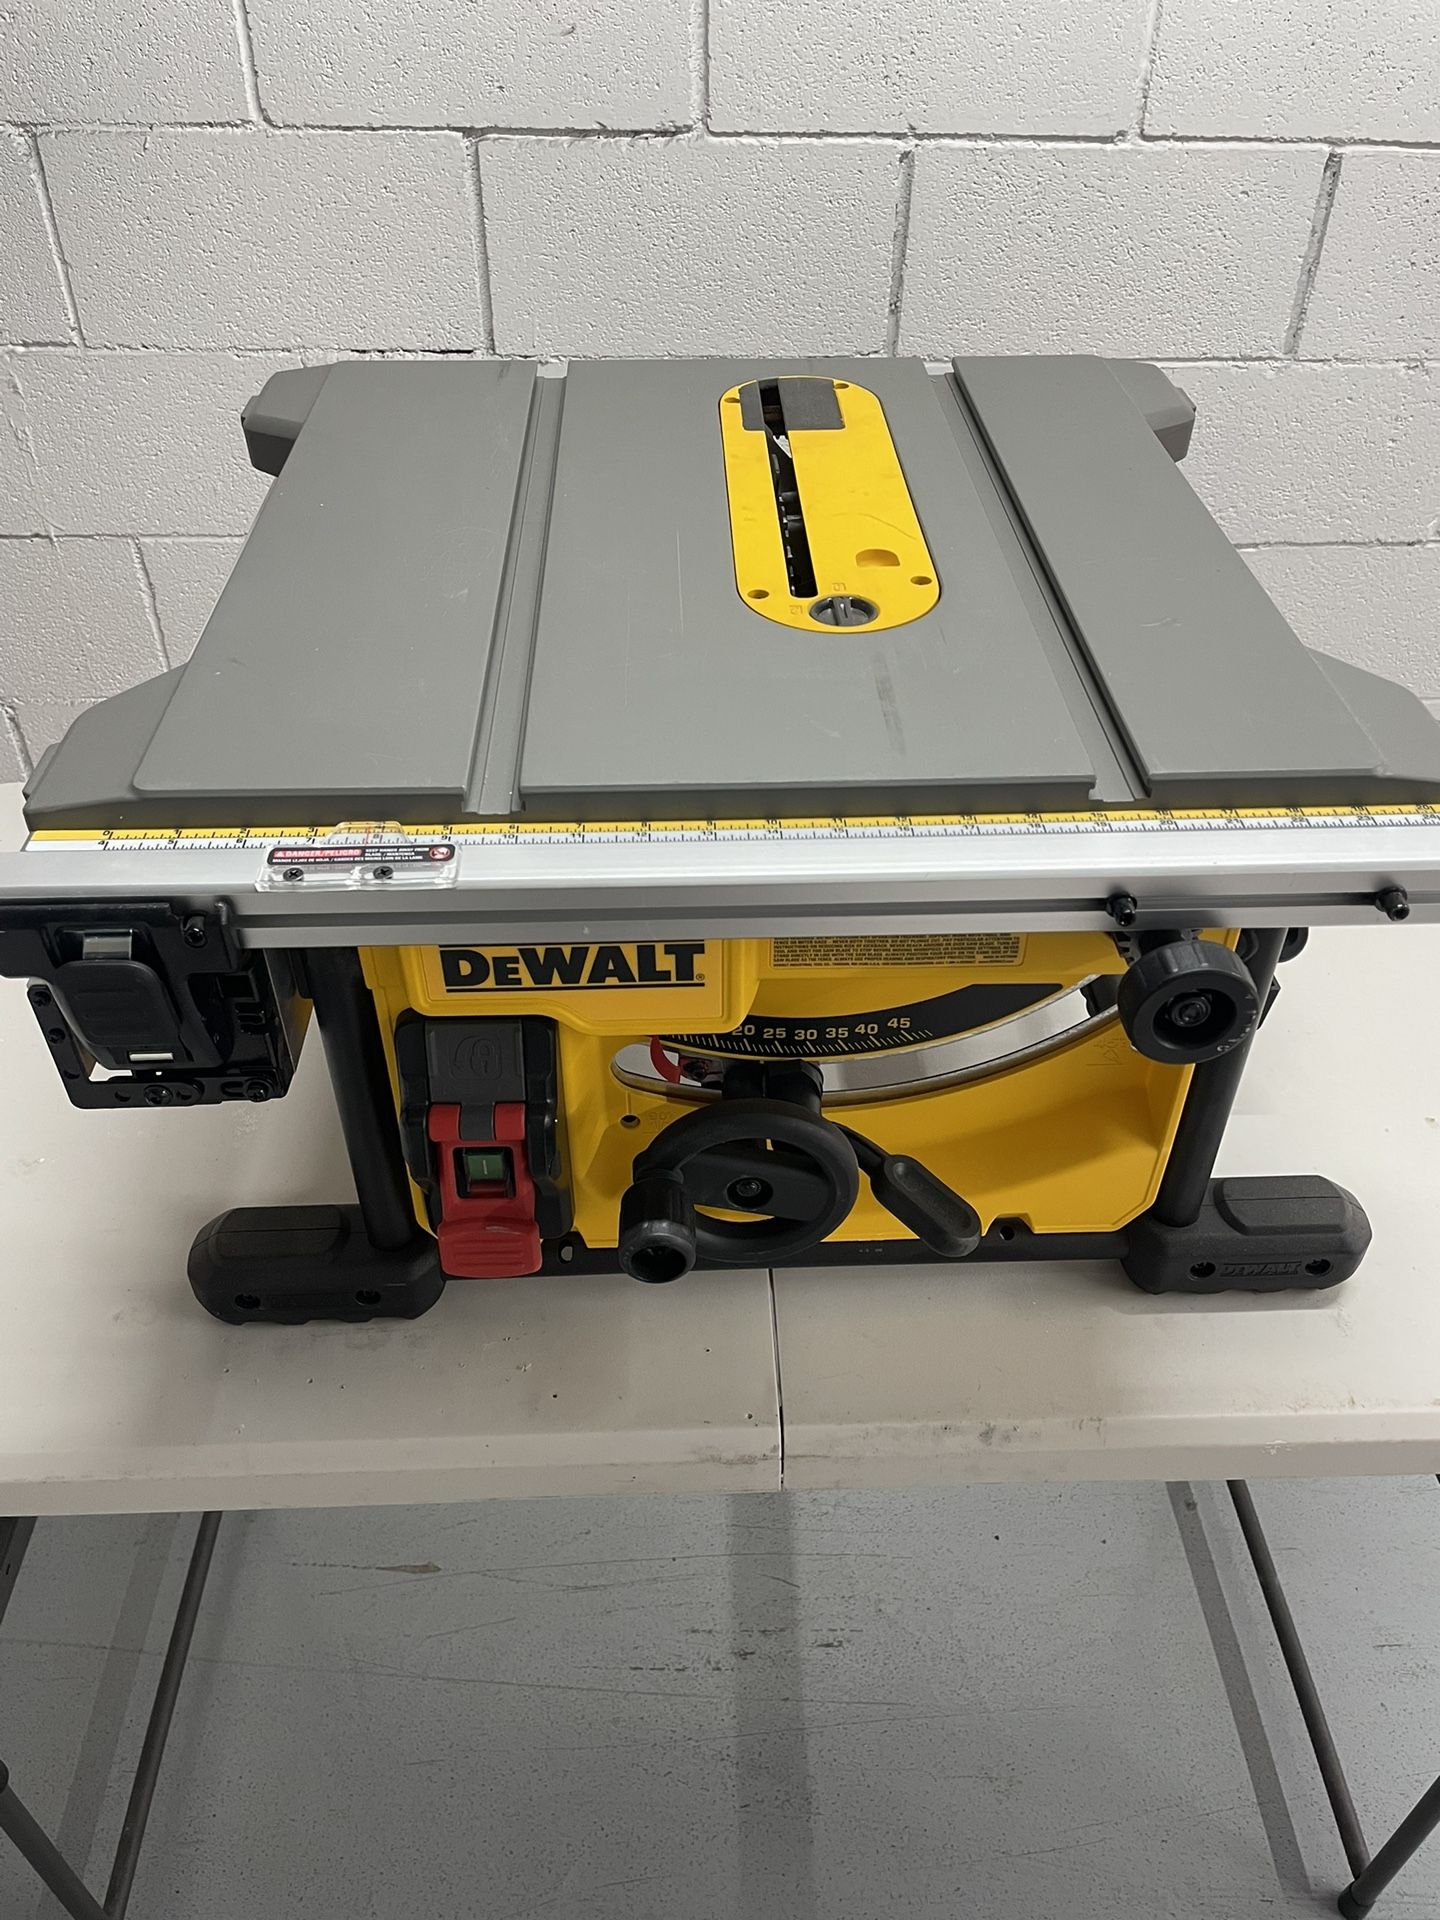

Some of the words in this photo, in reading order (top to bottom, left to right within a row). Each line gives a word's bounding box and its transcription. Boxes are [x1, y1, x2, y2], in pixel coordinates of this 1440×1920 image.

[440, 943, 706, 986] DEWALT
[732, 1024, 756, 1036] 20
[763, 1028, 786, 1038] 25
[794, 1029, 818, 1040] 30
[826, 1027, 849, 1038] 35
[854, 1023, 878, 1035] 40
[887, 1018, 912, 1030] 45
